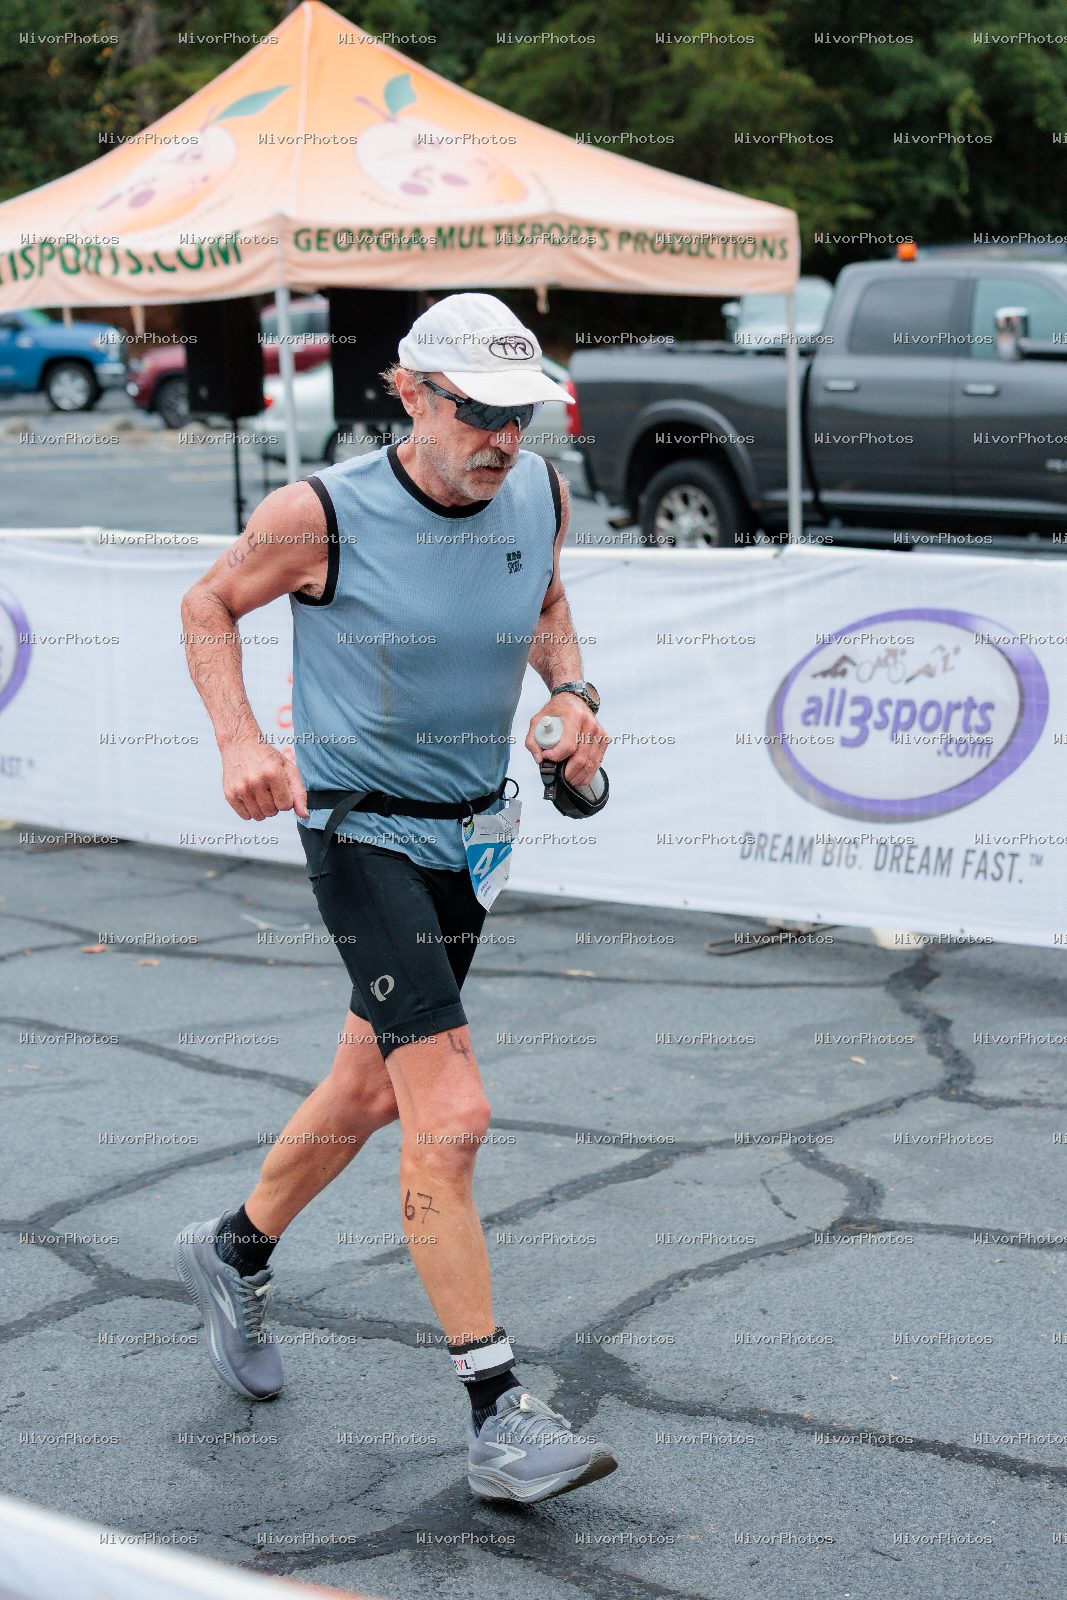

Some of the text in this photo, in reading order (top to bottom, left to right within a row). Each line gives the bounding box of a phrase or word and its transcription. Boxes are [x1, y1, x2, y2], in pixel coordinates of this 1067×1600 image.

[293, 221, 789, 260] GEORGIA MULTISPORTS PRODUCTIONS
[800, 687, 995, 748] all3sports
[936, 738, 991, 758] .com
[739, 830, 814, 866] DREAM
[821, 840, 863, 871] BIG.
[873, 843, 954, 878] DREAM
[404, 1188, 440, 1225] 67
